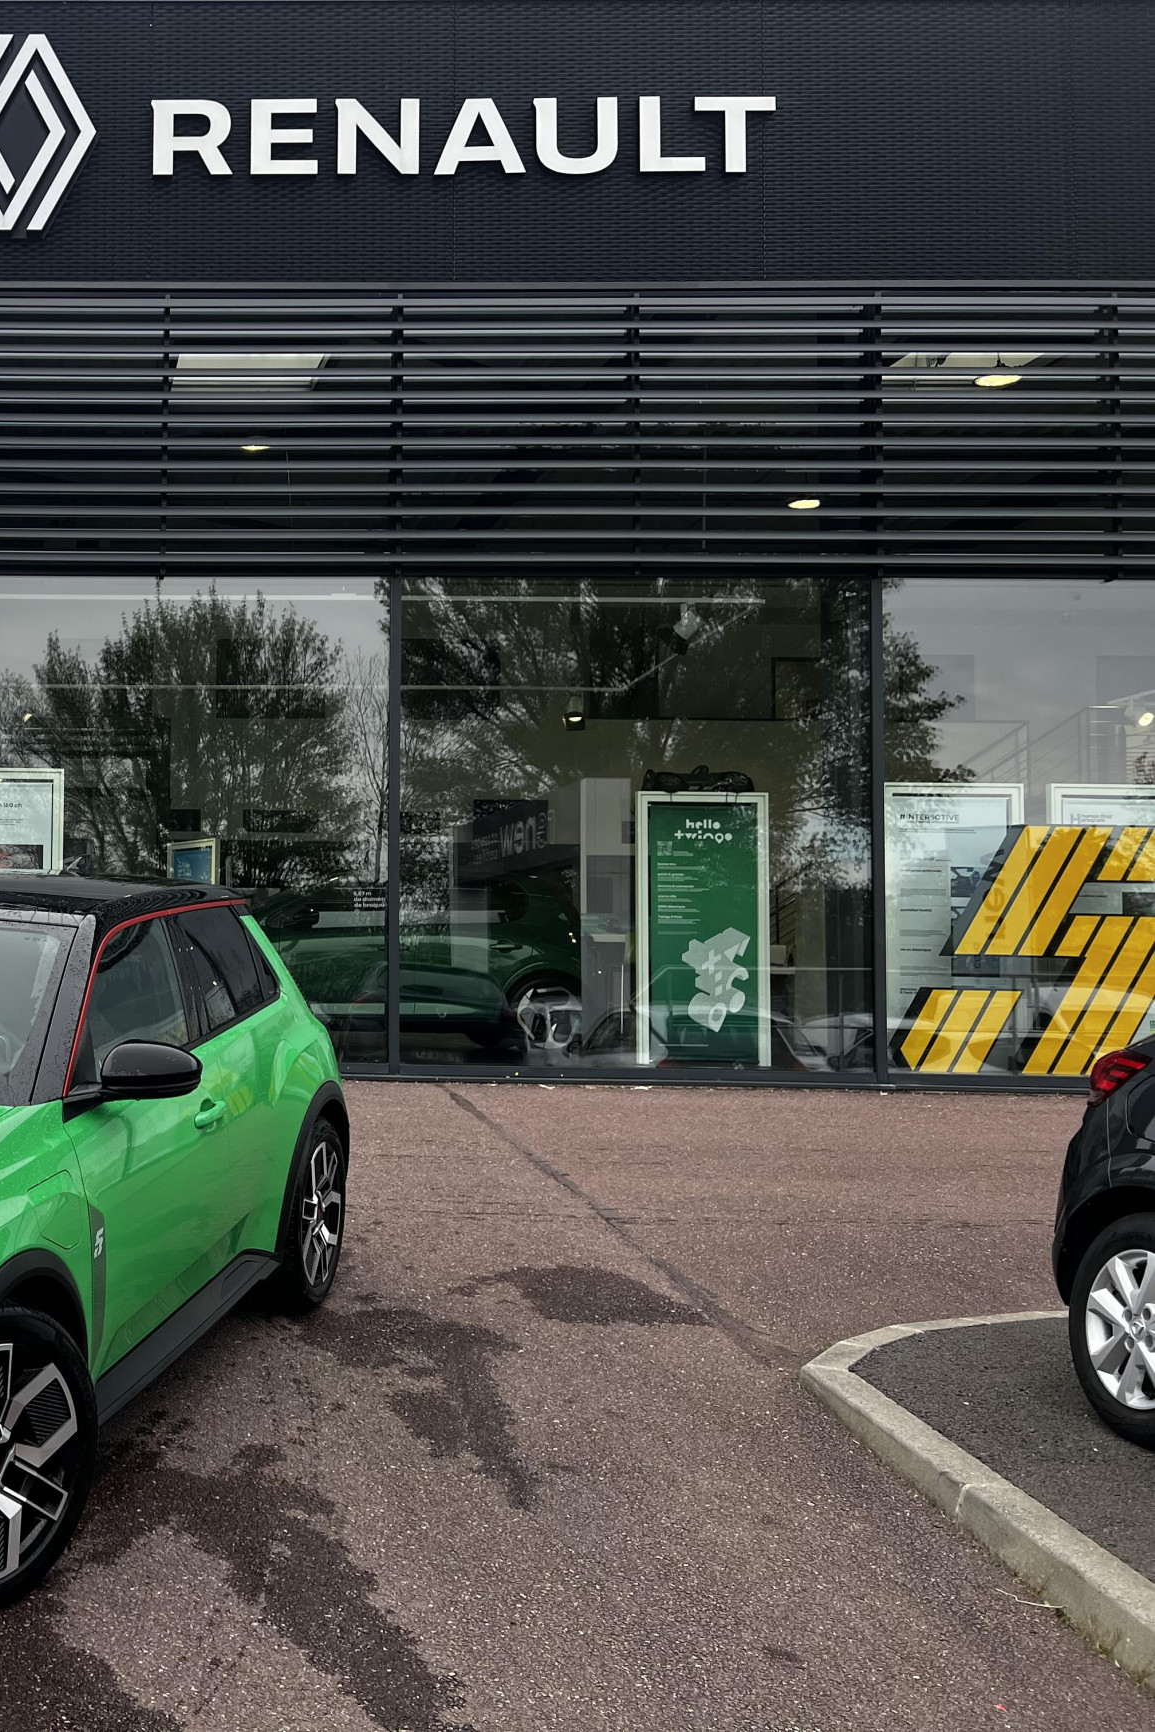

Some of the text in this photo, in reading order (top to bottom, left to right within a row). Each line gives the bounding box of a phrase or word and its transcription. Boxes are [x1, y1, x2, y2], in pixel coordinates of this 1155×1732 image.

[152, 95, 776, 176] RENAULT
[685, 819, 721, 830] hello
[674, 829, 733, 844] twingo
